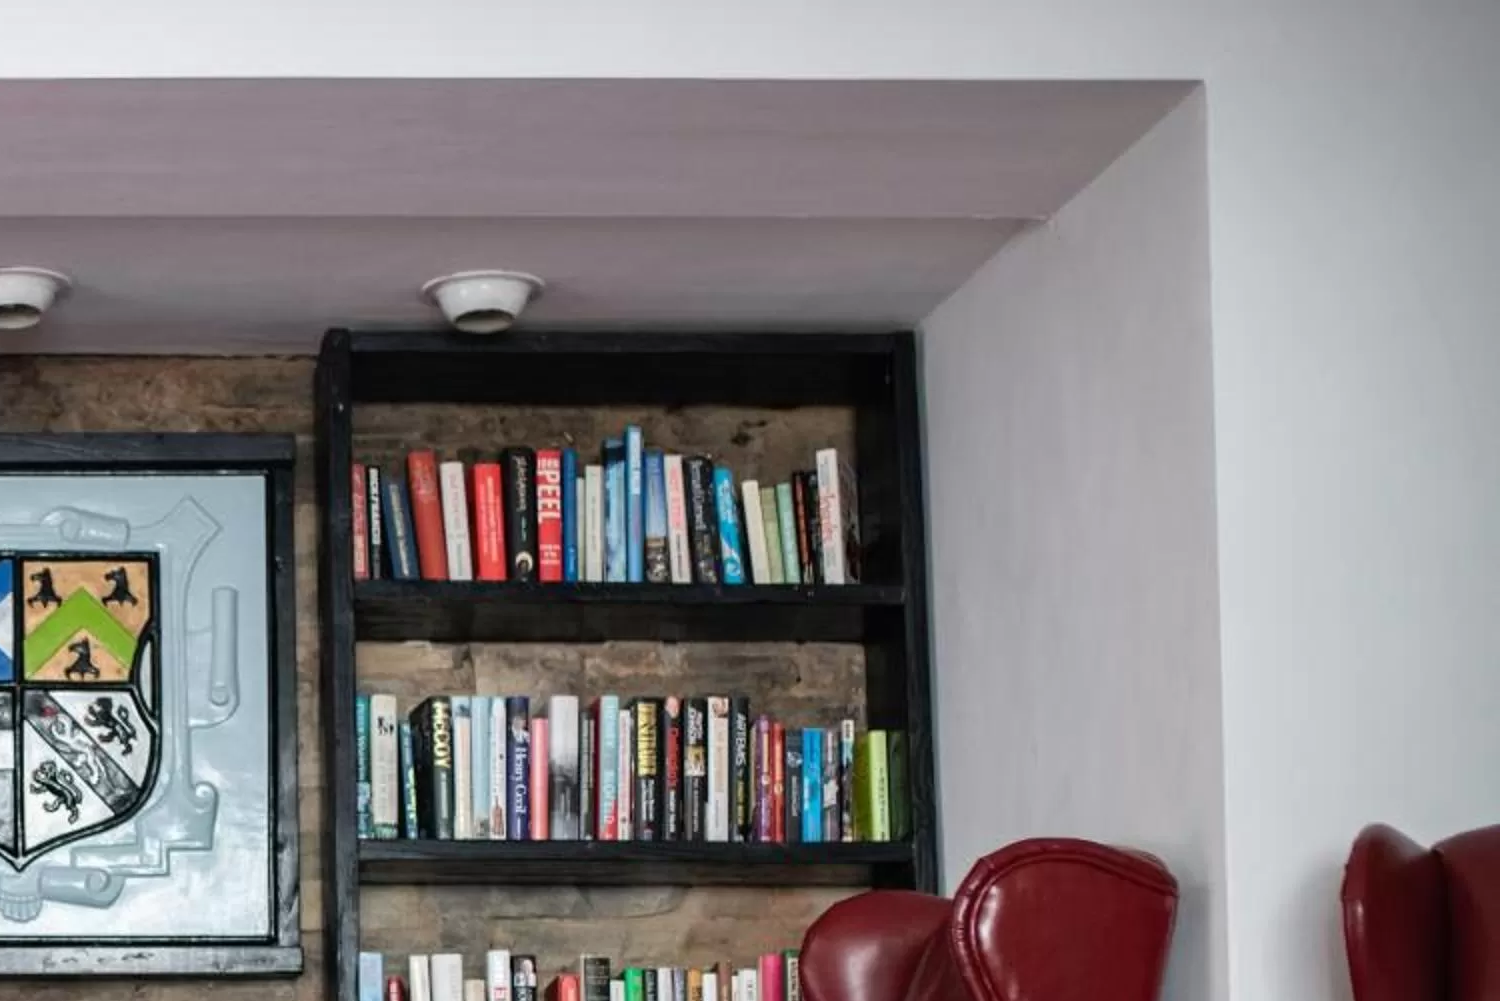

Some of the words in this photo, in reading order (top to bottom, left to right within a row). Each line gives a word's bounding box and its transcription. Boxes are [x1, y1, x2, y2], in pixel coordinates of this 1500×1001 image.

[538, 470, 561, 524] PEEL
[433, 702, 451, 768] McCOY
[736, 713, 745, 767] ARTEMIS
[509, 746, 526, 782] Henry
[515, 784, 526, 813] Cecil
